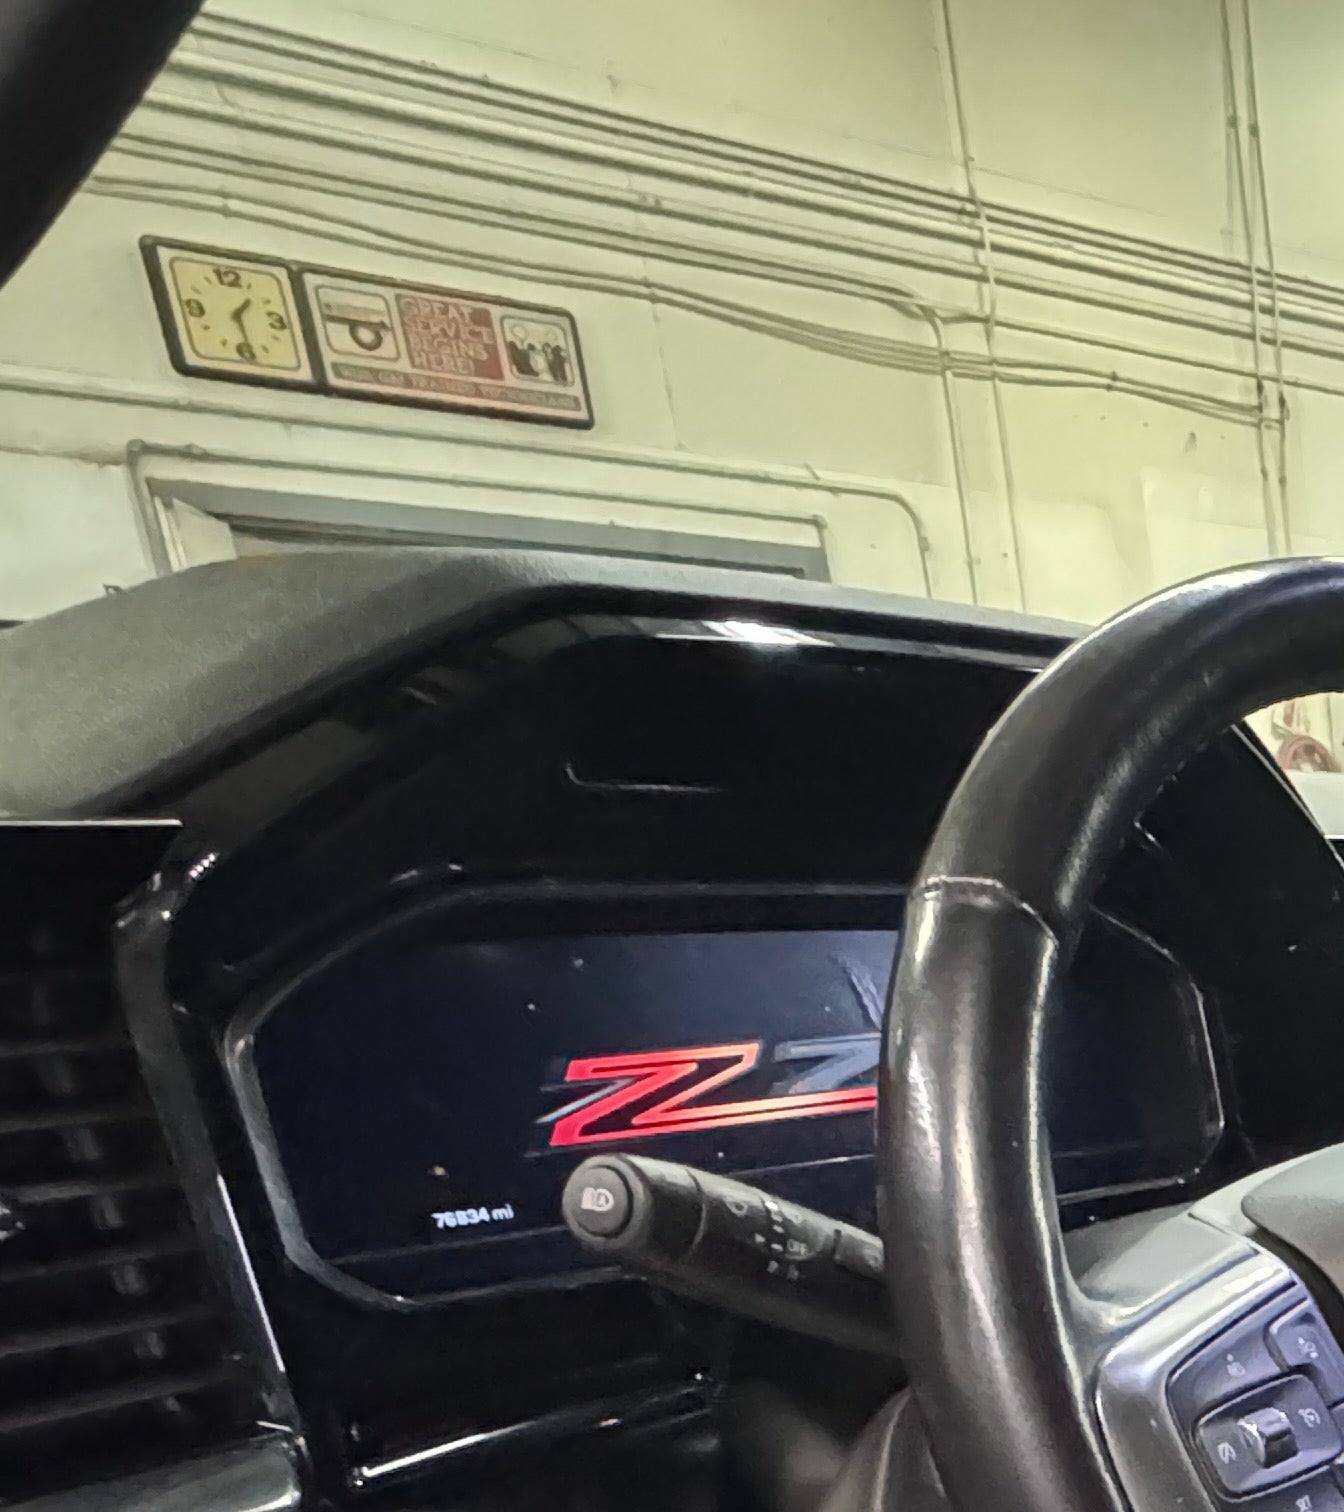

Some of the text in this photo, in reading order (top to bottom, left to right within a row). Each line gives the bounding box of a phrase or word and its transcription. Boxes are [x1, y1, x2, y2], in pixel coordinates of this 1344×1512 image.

[213, 267, 242, 289] 12
[265, 311, 287, 331] 3
[401, 297, 473, 323] GREAT
[403, 315, 498, 345] SERVICE
[235, 342, 257, 361] 6
[408, 332, 489, 361] BEGINS
